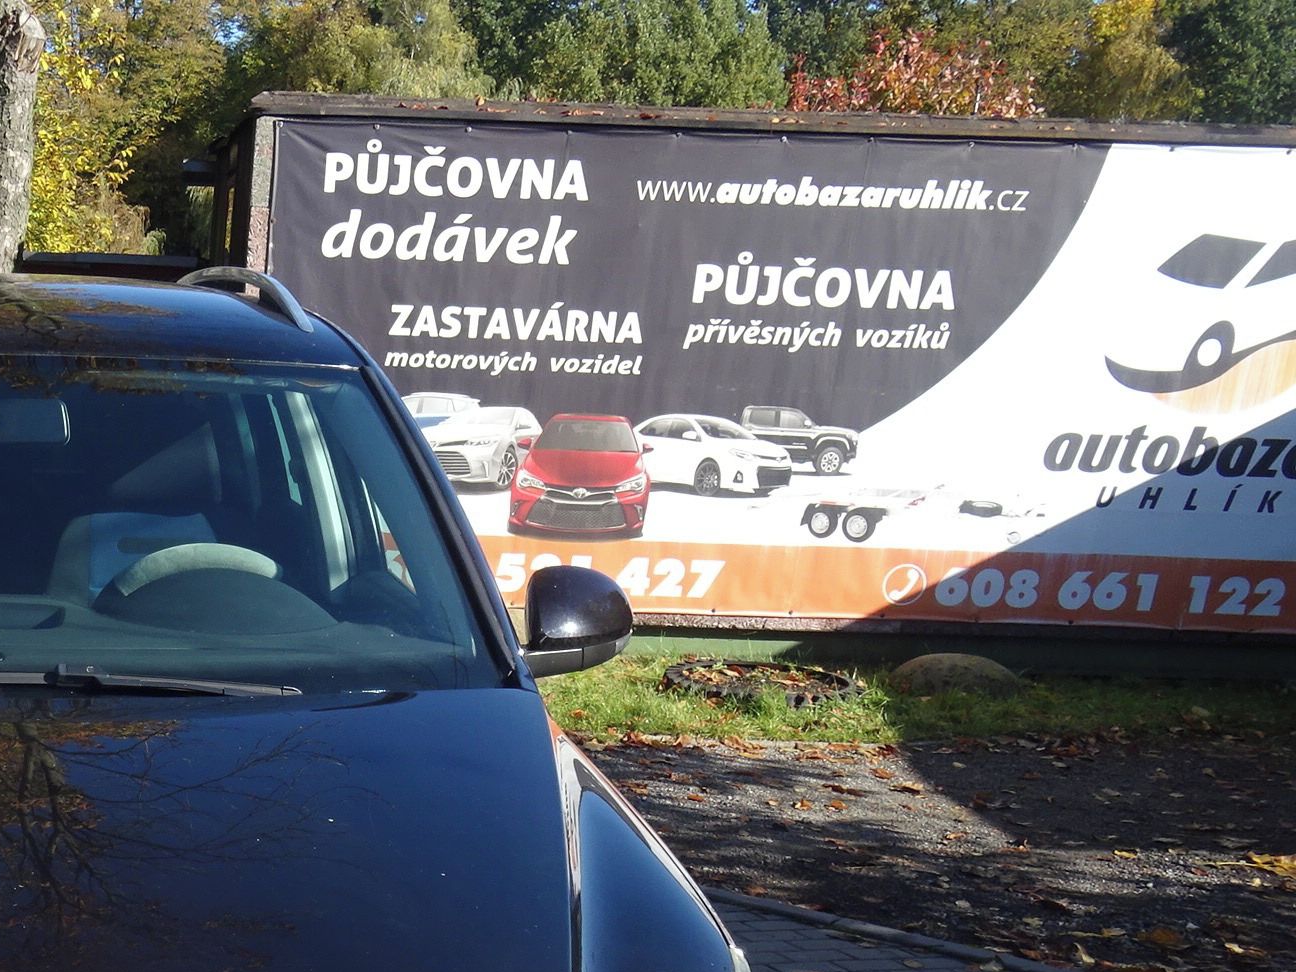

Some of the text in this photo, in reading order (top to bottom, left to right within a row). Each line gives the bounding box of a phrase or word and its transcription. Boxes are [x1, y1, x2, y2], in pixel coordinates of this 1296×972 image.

[323, 138, 589, 202] PŮJČOVNA
[636, 175, 1030, 212] www.autobazaruhlik.cz
[321, 208, 578, 265] dodávek
[691, 251, 955, 311] PŮJČOVNA
[388, 301, 643, 344] ZASTAVÁRNA
[682, 318, 951, 353] přívěsných vozíků
[384, 349, 643, 376] motorových vozidel
[614, 556, 726, 599] 427
[934, 567, 1286, 617] 608 661 122
